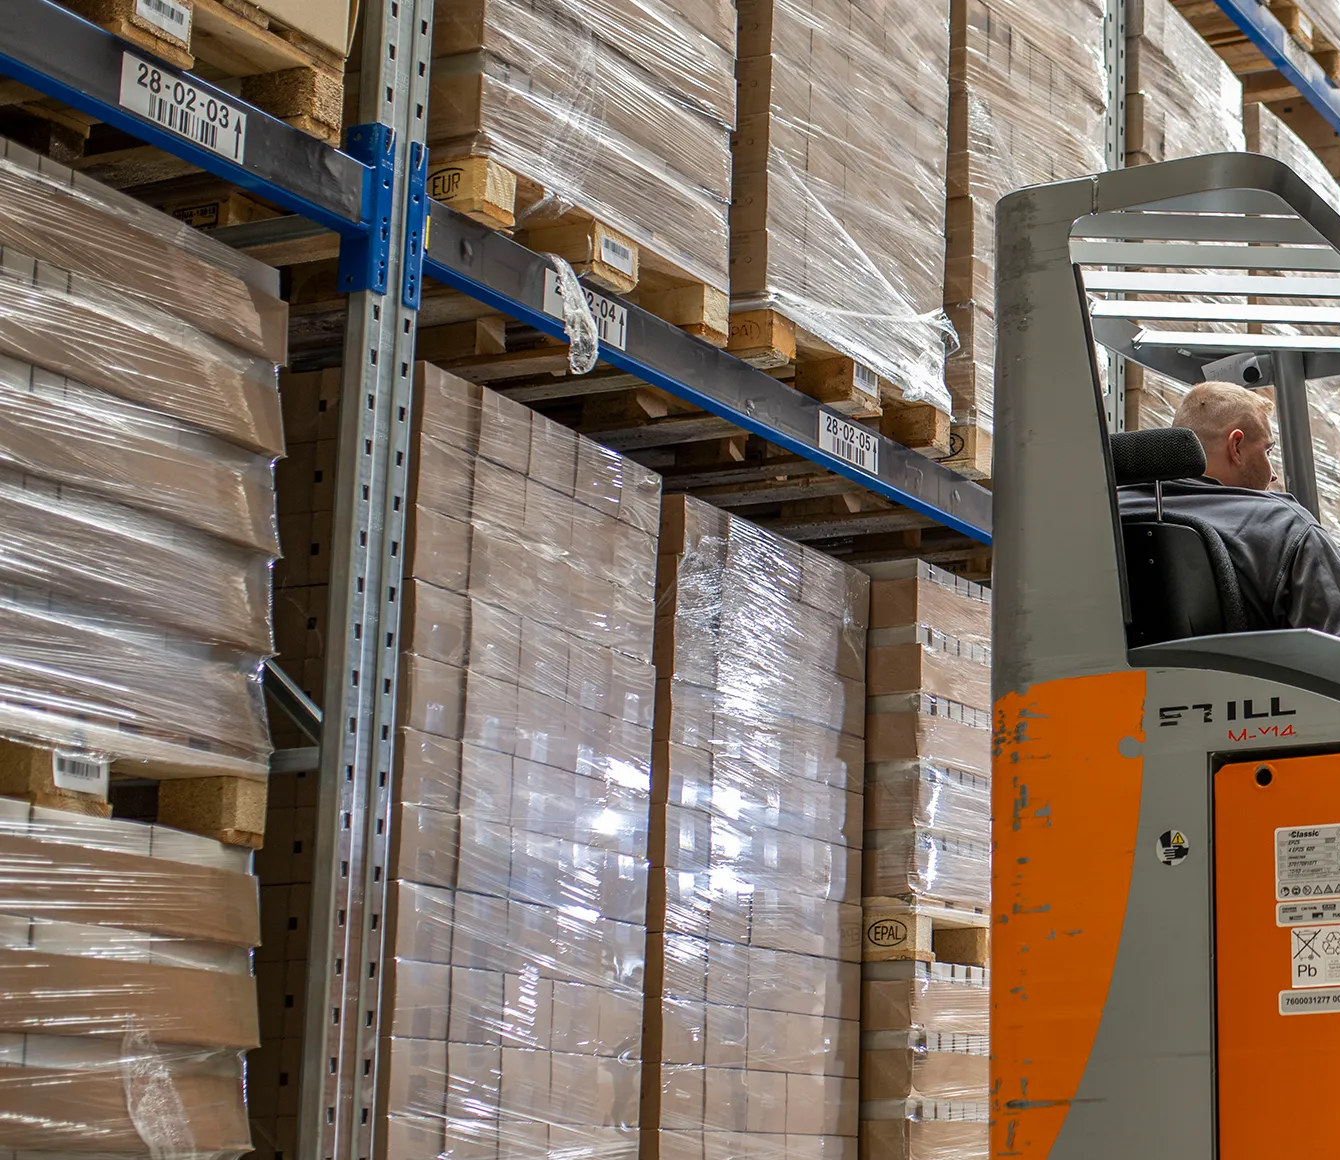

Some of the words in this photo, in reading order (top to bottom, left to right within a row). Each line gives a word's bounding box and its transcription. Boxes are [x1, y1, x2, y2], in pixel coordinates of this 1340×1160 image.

[137, 63, 229, 129] 28-02-03
[432, 172, 461, 197] EUR
[826, 415, 871, 451] 28-02-05
[1291, 830, 1319, 838] Classic
[874, 925, 902, 940] EPAL
[1297, 964, 1317, 978] Pb
[1285, 995, 1331, 1006] 7600031277
